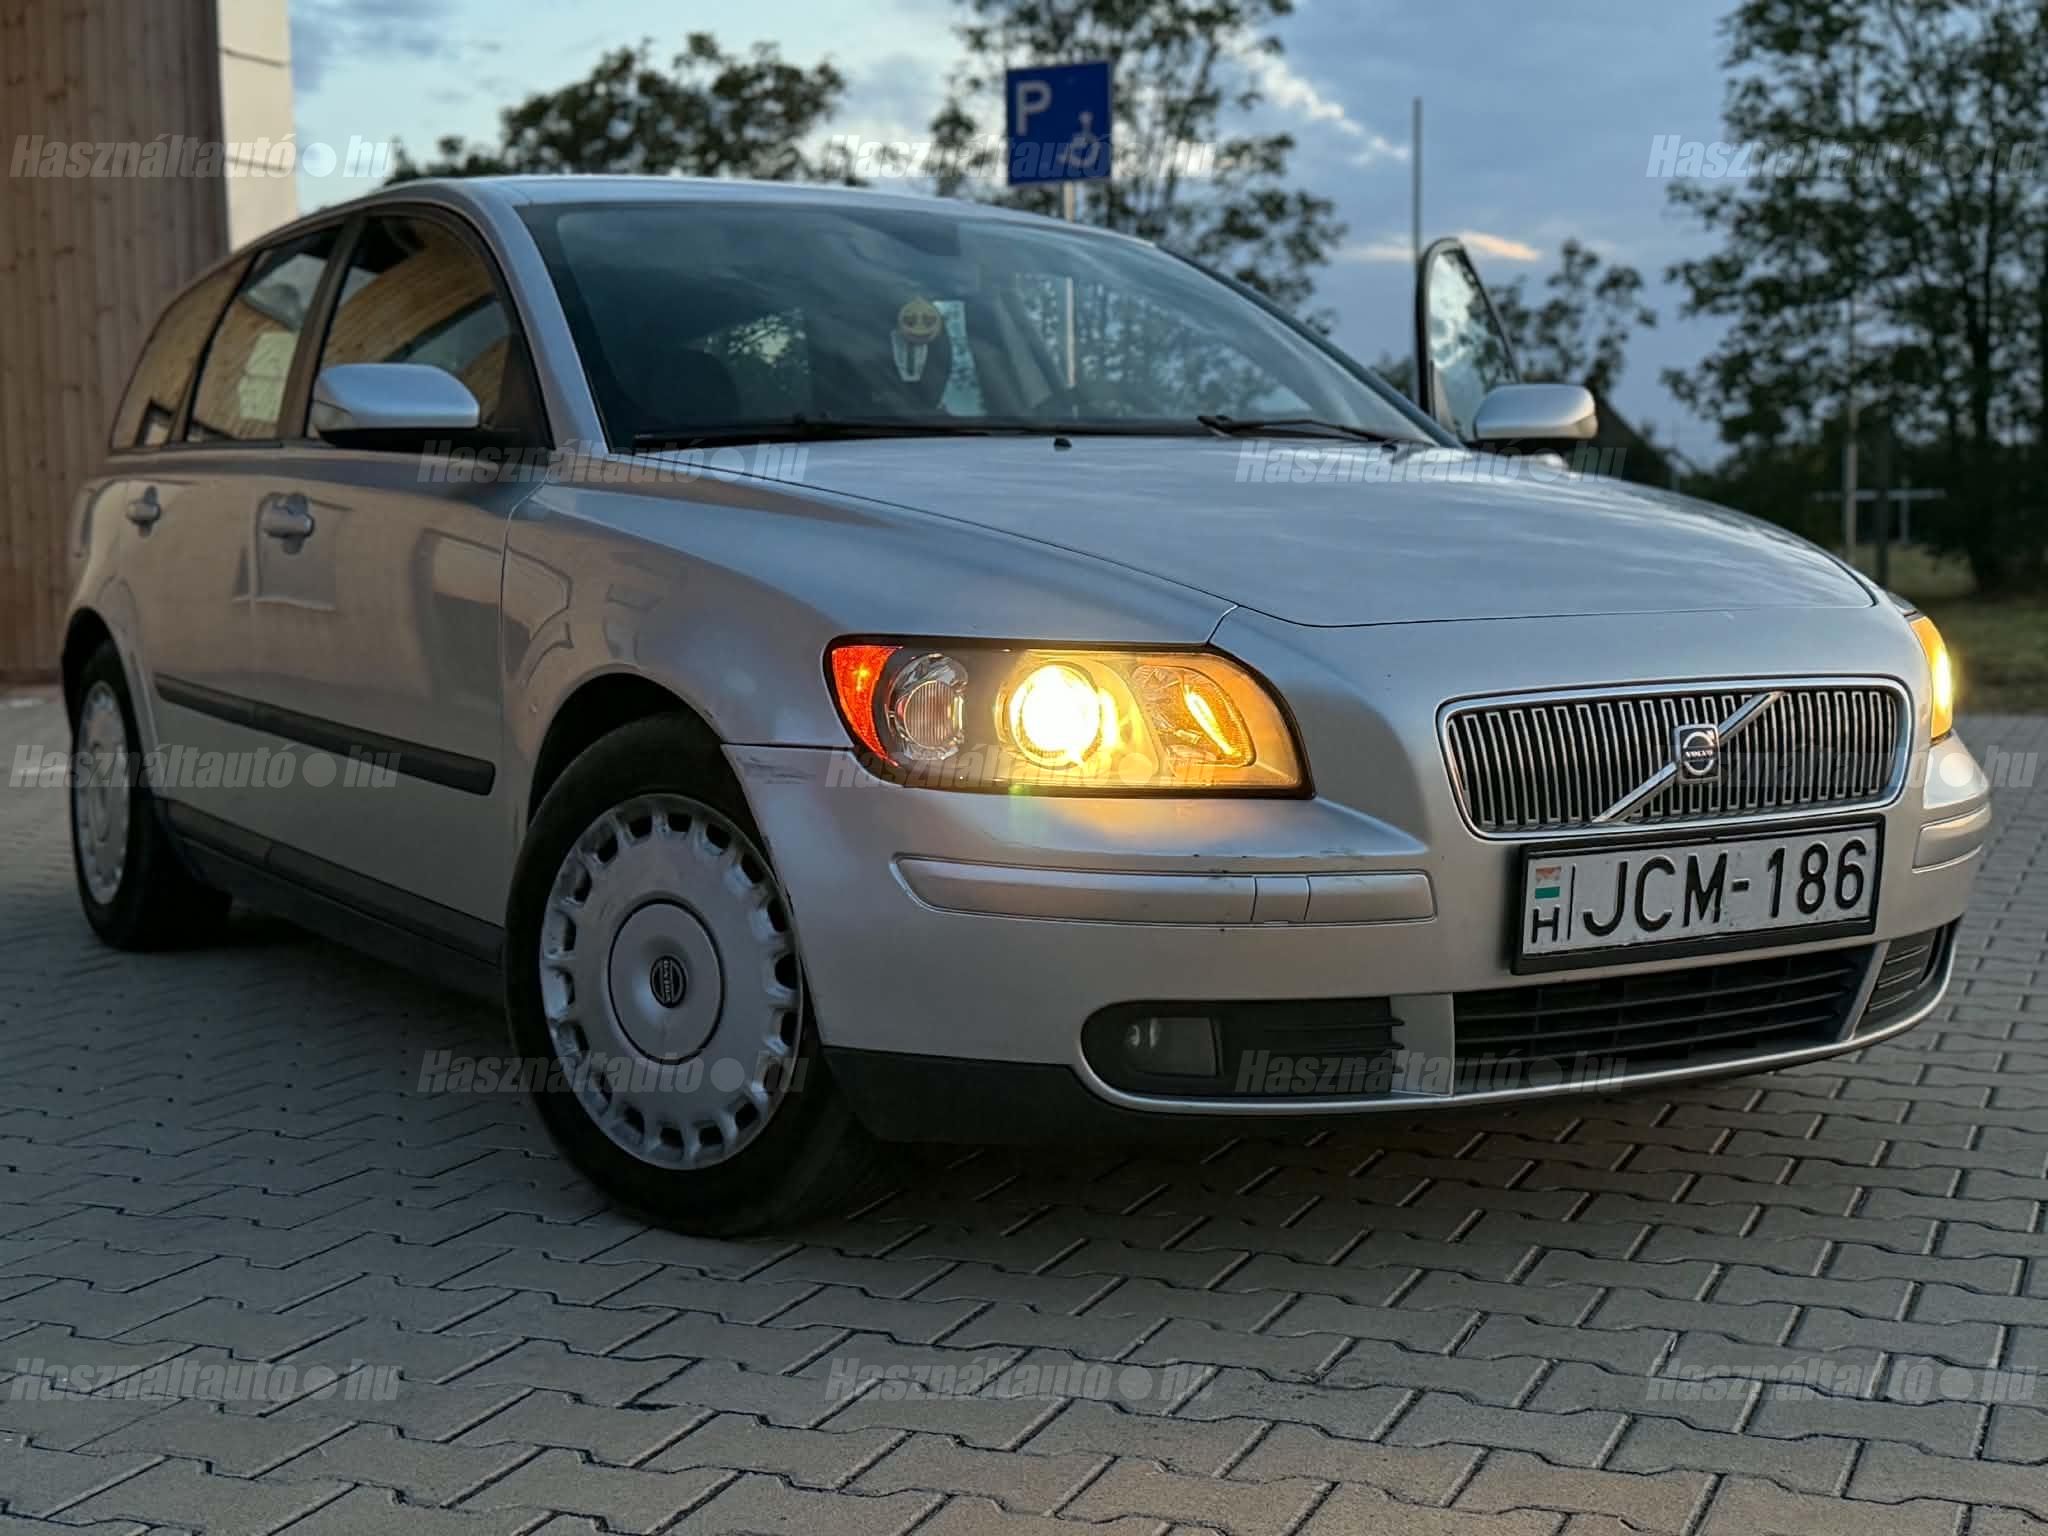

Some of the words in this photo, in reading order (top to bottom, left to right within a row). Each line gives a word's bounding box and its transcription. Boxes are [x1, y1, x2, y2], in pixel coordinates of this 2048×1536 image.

[1015, 80, 1052, 136] P
[1685, 749, 1713, 758] VOLVO
[1532, 906, 1560, 943] H
[1582, 838, 1868, 937] JCM-186
